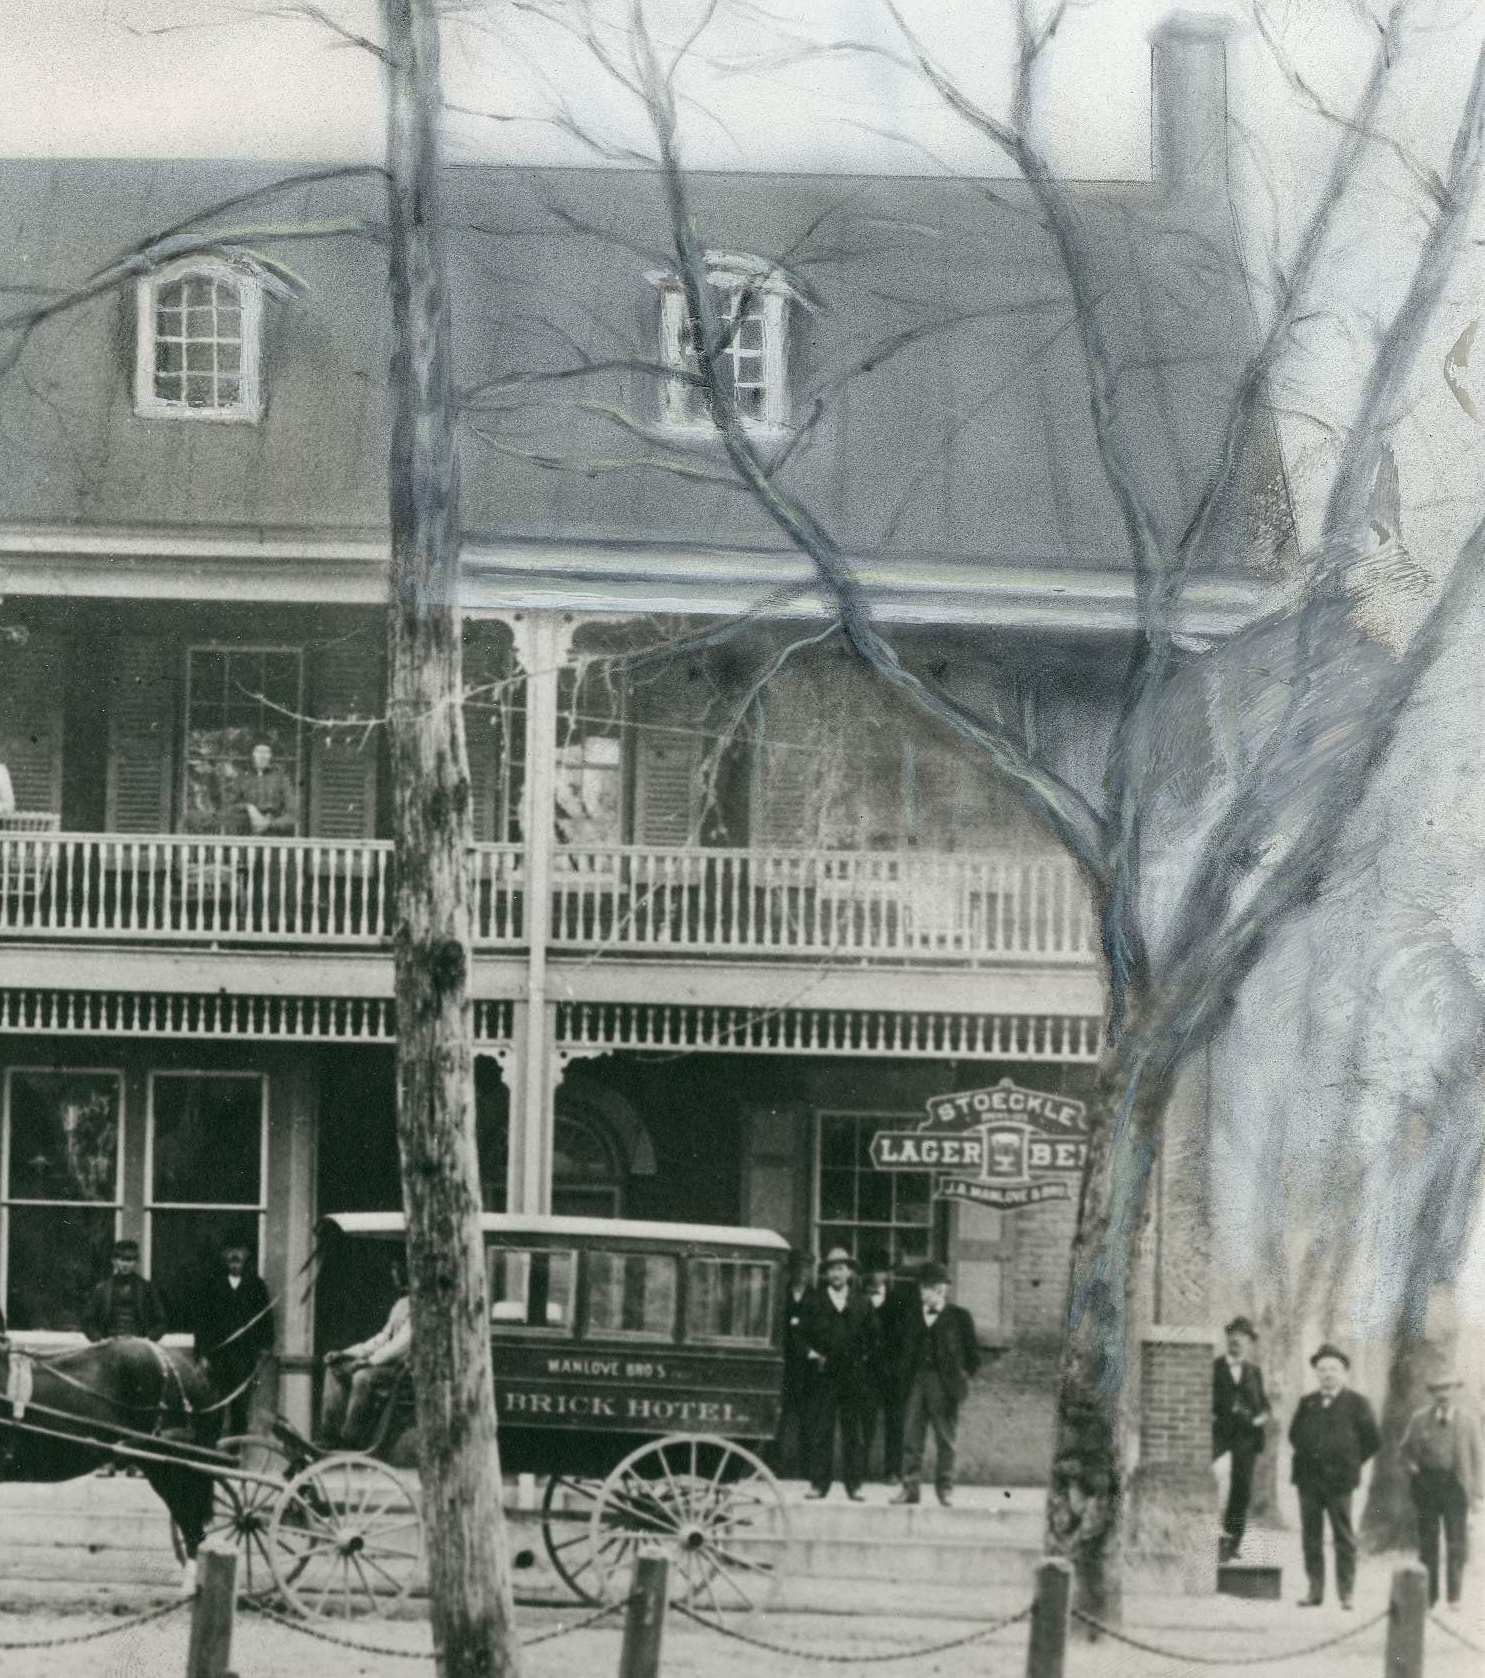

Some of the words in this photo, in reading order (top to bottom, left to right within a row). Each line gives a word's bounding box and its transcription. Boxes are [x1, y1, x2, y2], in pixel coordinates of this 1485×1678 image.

[937, 1091, 1077, 1127] STOECKLE
[880, 1138, 981, 1164] LAGER
[547, 1357, 620, 1377] MANLOVE
[505, 1391, 615, 1416] BRICK
